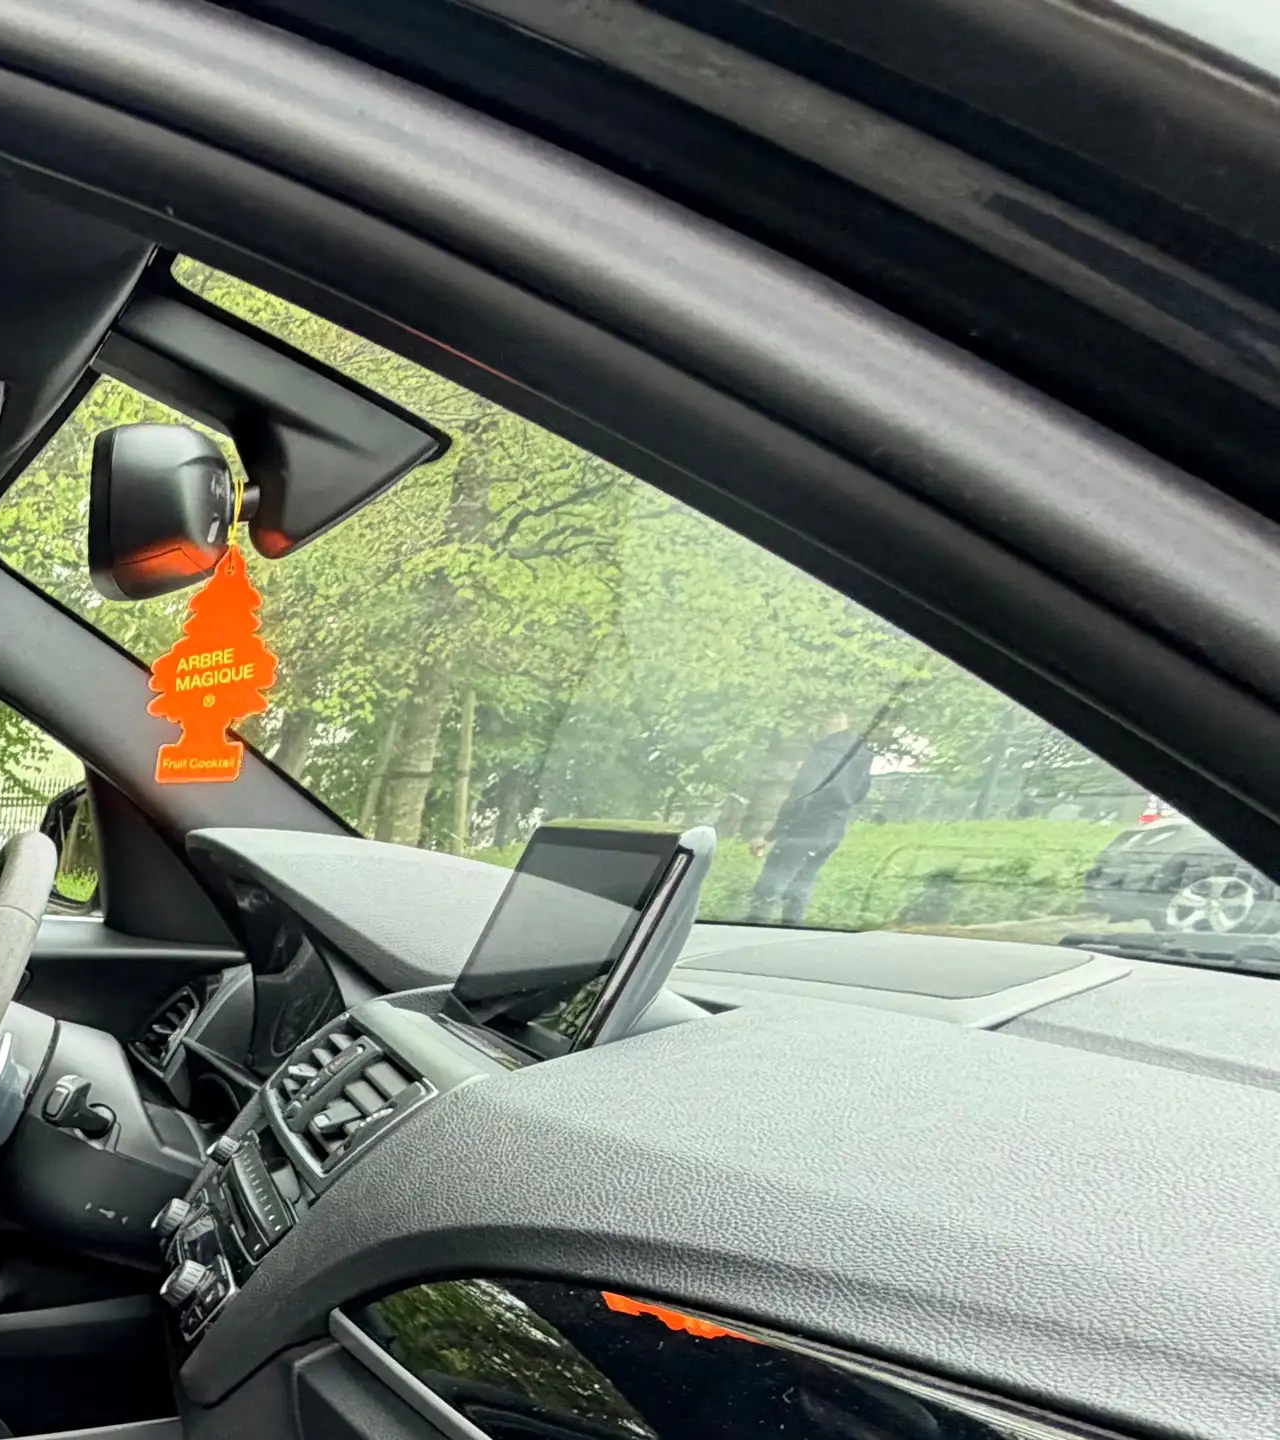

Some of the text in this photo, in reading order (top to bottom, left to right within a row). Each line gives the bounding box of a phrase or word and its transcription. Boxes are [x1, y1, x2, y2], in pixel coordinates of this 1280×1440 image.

[176, 647, 235, 674] ARBRE
[175, 663, 255, 693] MAGIQUE
[162, 756, 236, 770] Fruit Cocktail
